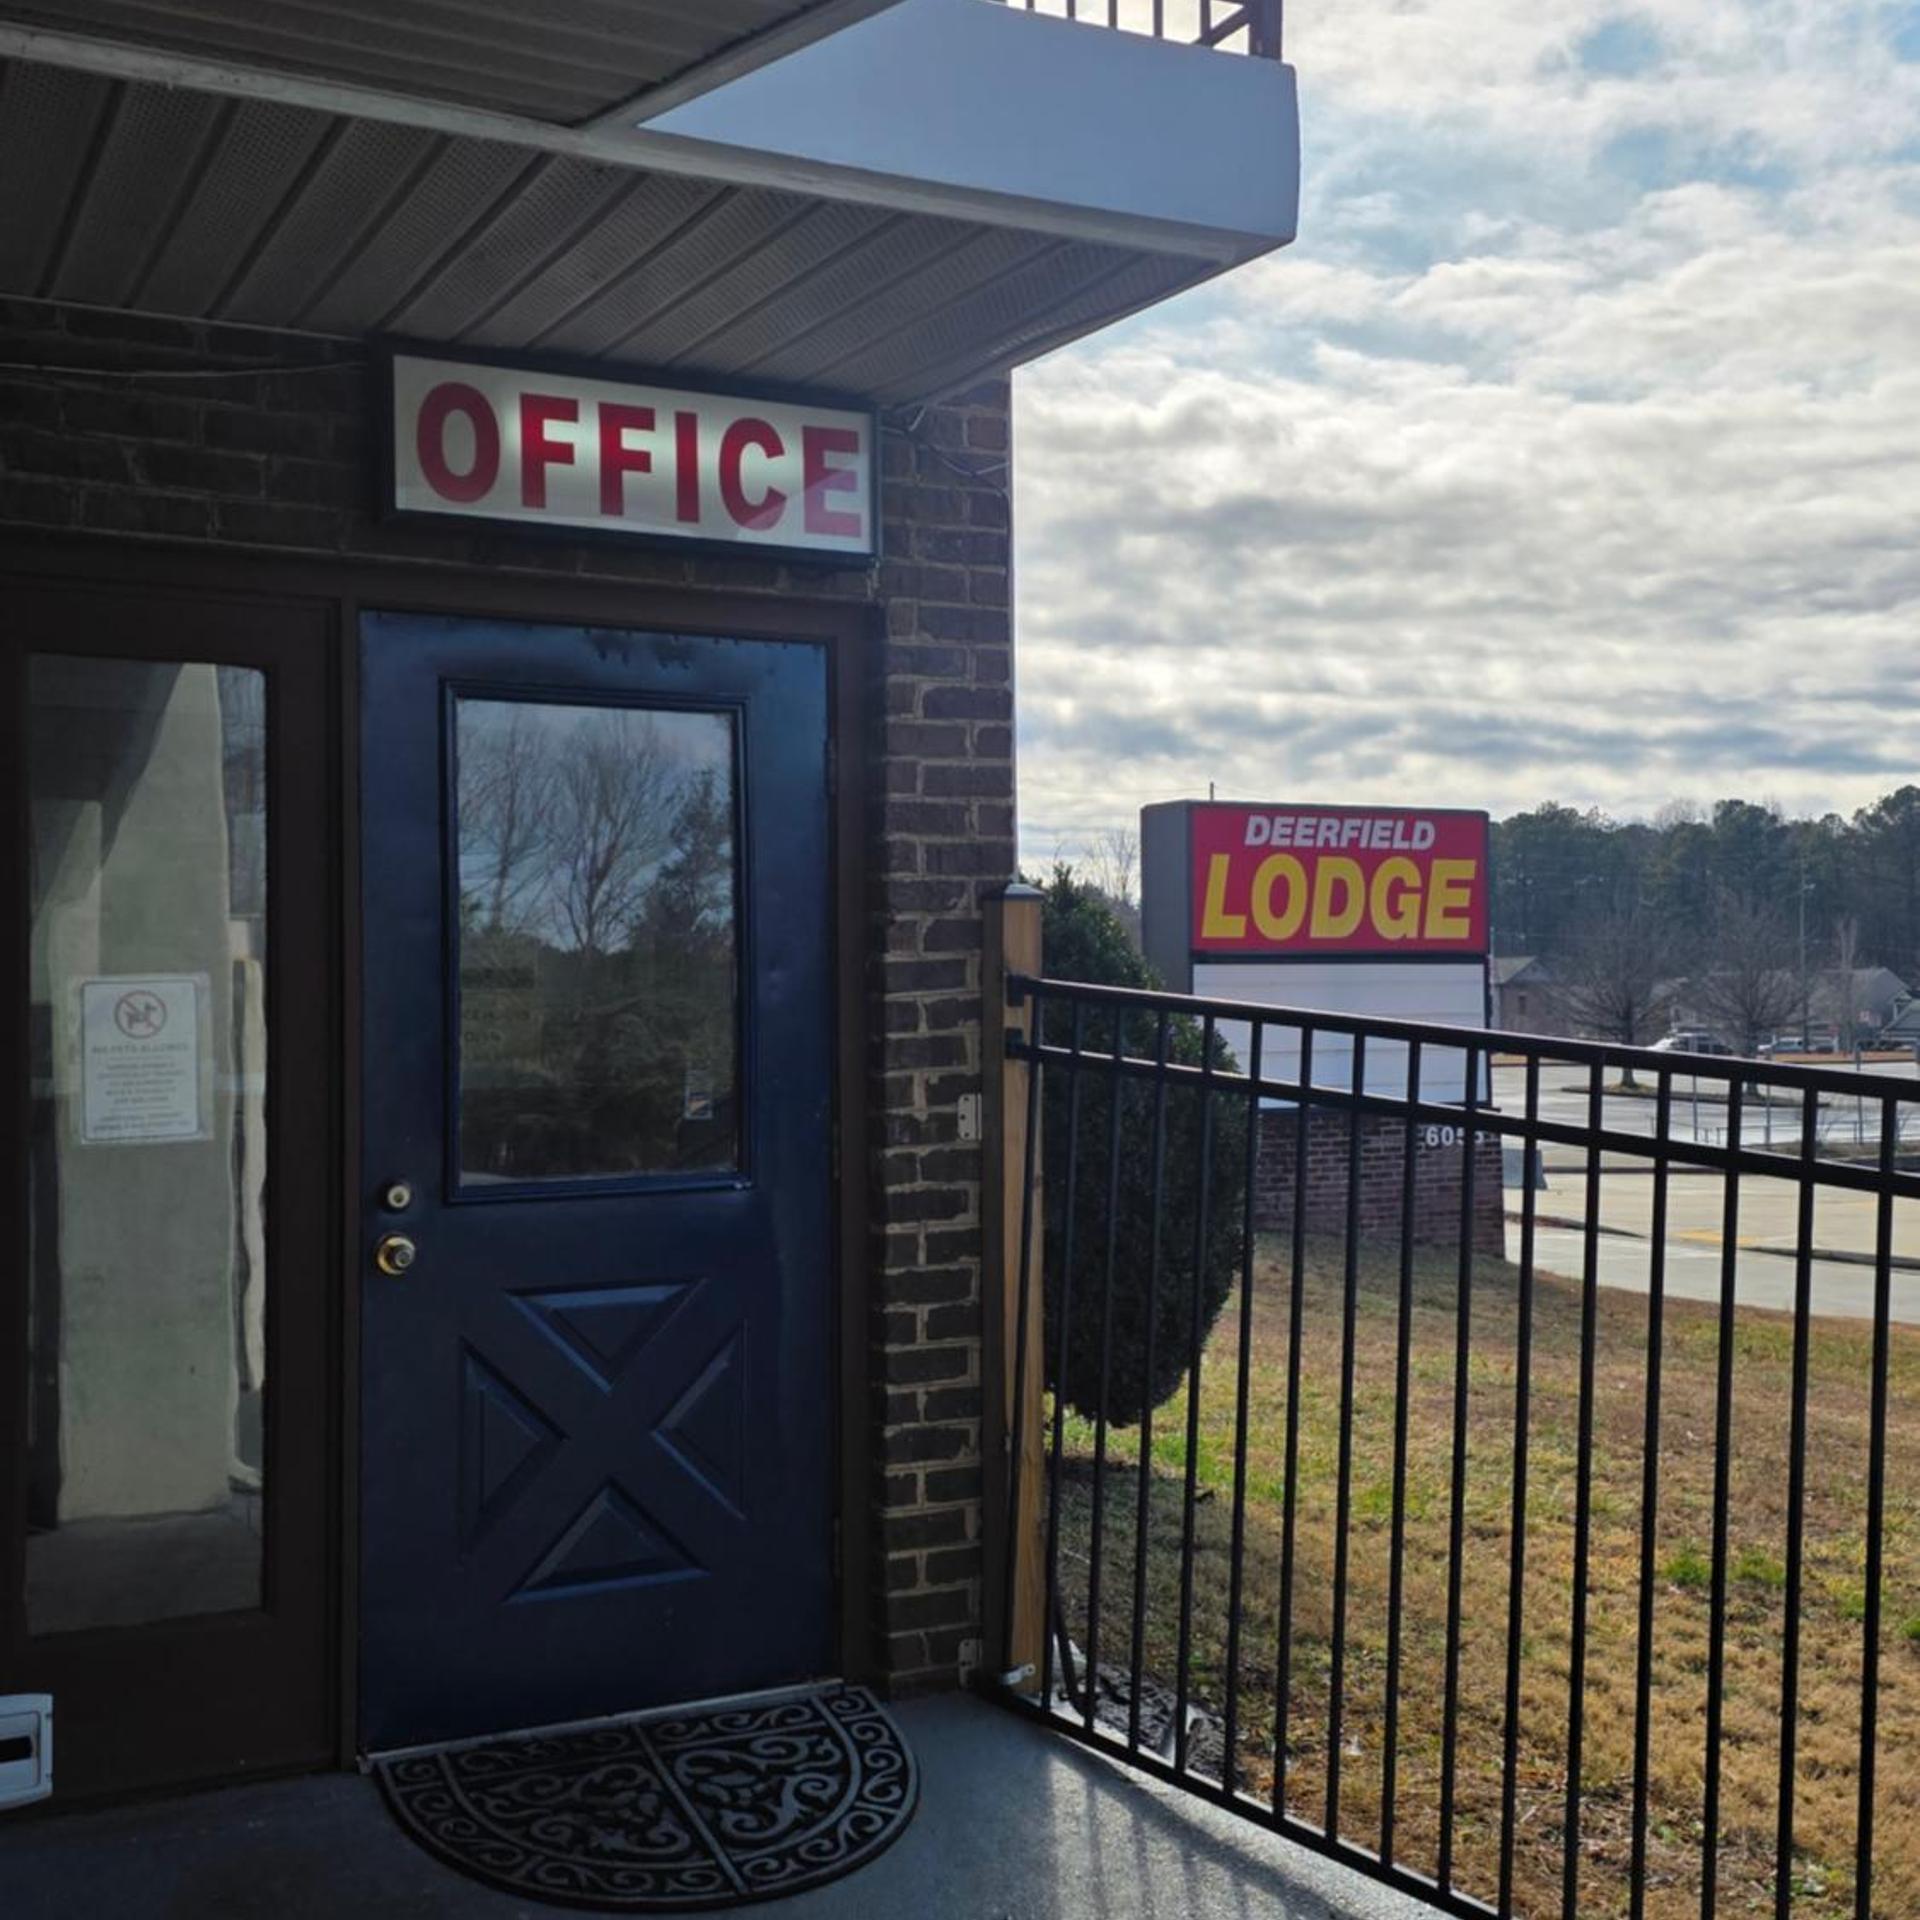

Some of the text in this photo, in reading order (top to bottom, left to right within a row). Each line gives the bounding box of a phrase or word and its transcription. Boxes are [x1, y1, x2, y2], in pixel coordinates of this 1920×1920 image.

[417, 381, 861, 538] OFFICE
[1244, 815, 1436, 851] DEERFIELD
[1201, 853, 1477, 941] LODGE
